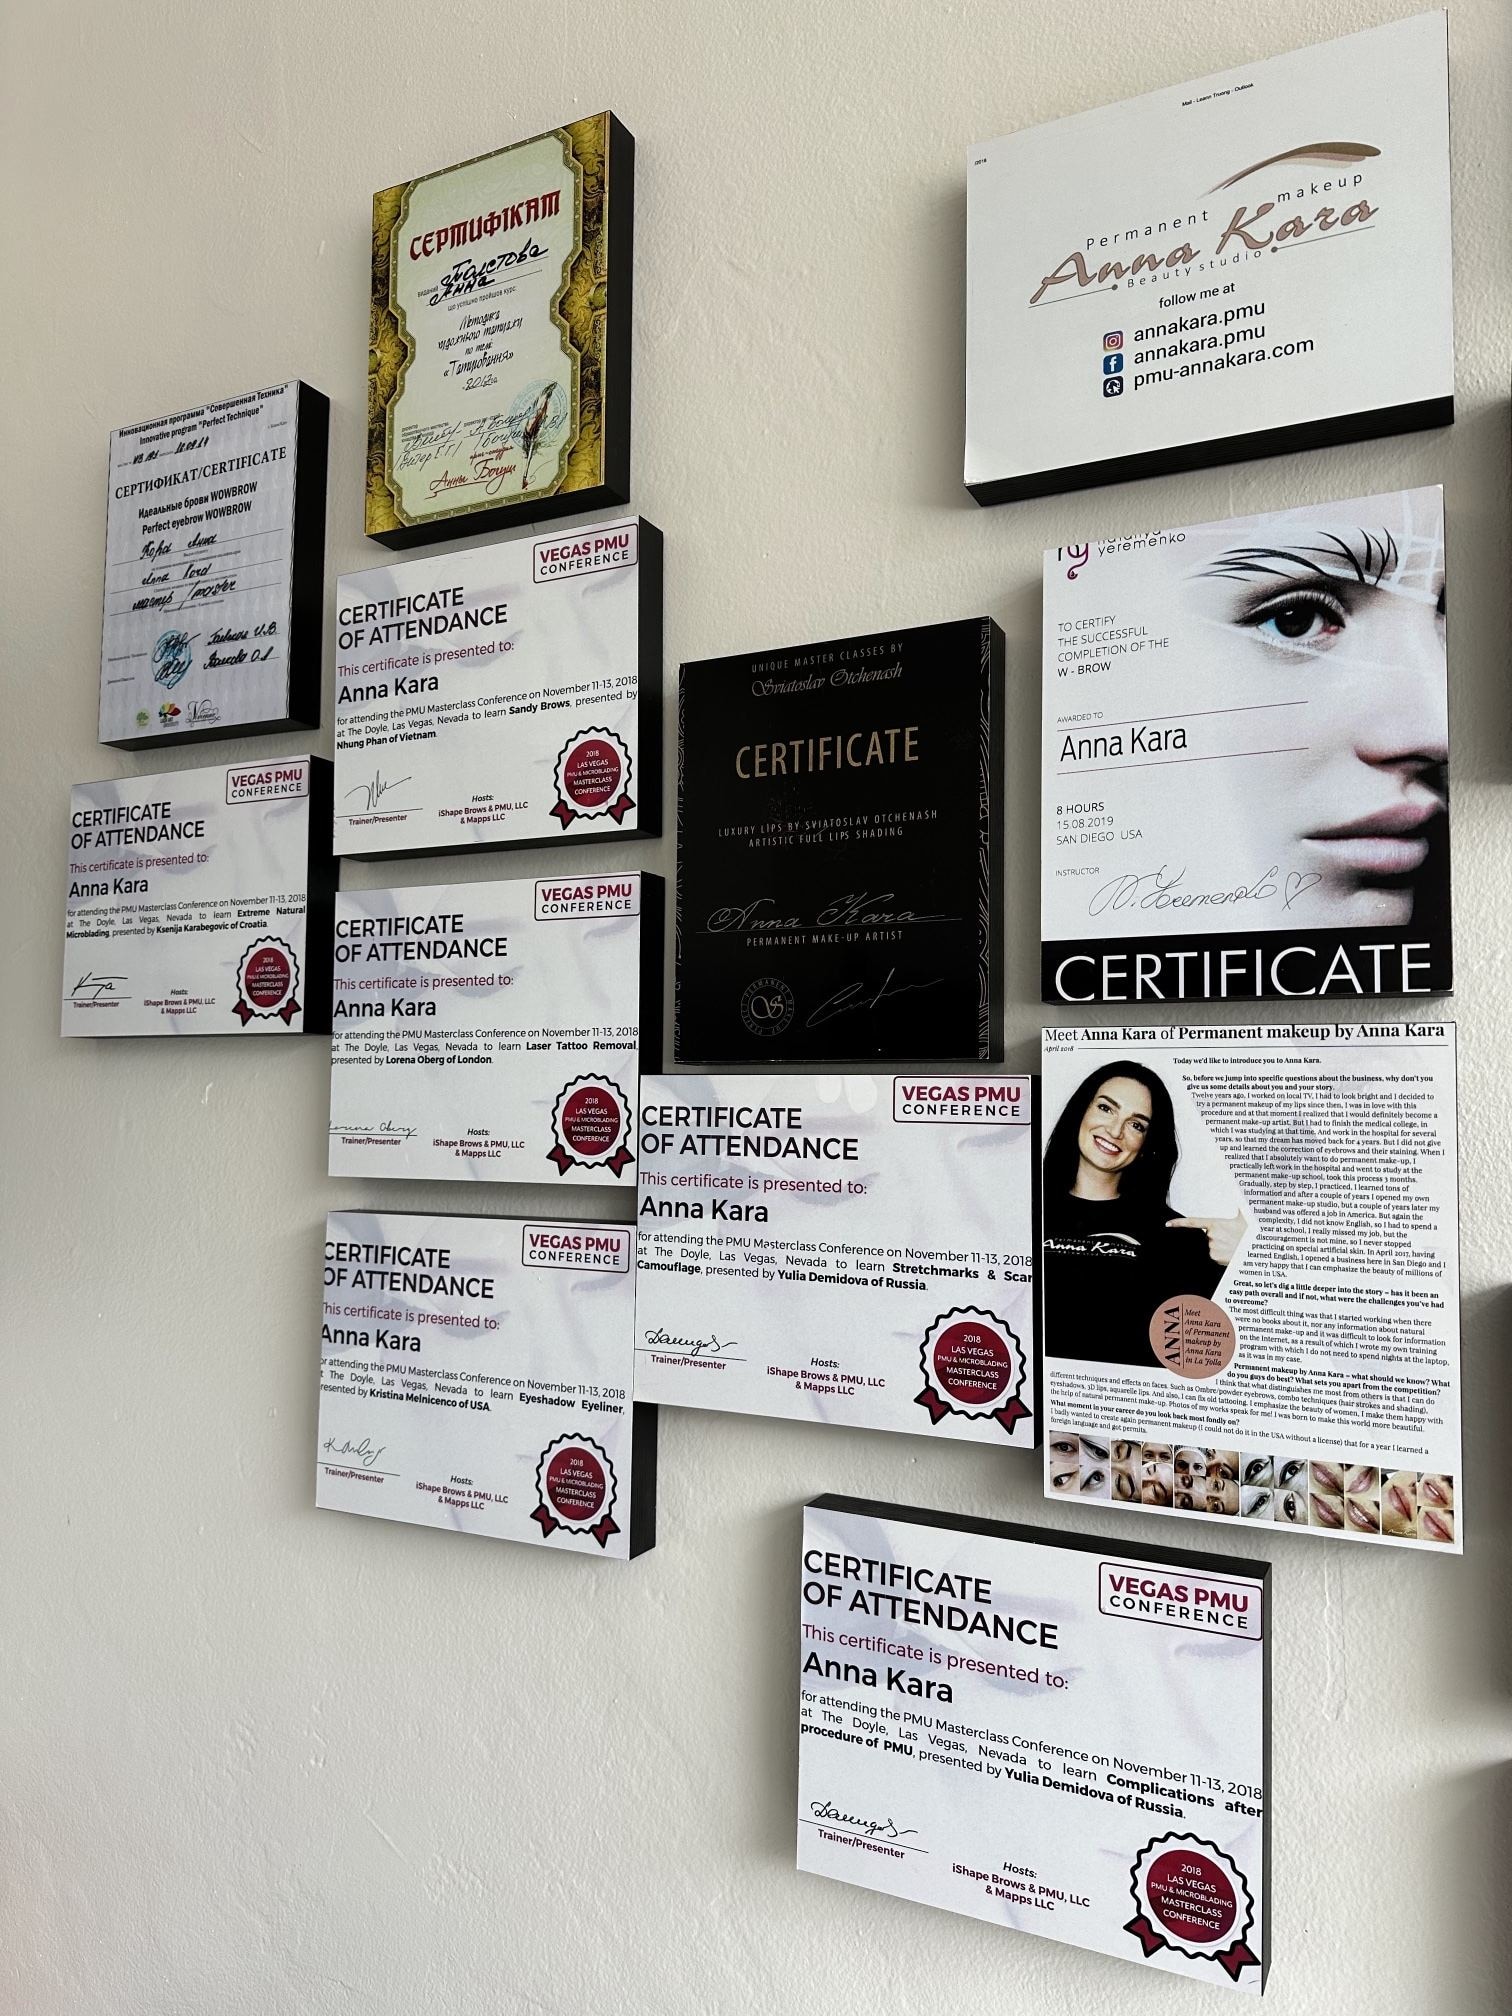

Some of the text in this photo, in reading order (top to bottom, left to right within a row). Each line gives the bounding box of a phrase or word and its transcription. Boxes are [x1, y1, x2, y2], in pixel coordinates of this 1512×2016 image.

[1087, 172, 1363, 251] Permanent makeup
[409, 191, 561, 259] СЕРТИФІКАТ
[1030, 200, 1379, 304] Anna Kara
[1127, 249, 1263, 288] Beauty studio
[1159, 282, 1235, 308] follow me at
[1134, 301, 1265, 342] annakara.pmu
[1134, 326, 1265, 365] annakara.pmu
[1134, 338, 1314, 390] pmu-annakara.com
[119, 385, 288, 438] Инновационная программа "Совершенная Техника"
[139, 404, 263, 445] Innovative program "Perfect Technique"
[115, 447, 286, 498] СЕРТИФИКАТ/CERTIFICATE
[138, 481, 258, 518] Идеальные брови WOWBROW
[142, 501, 252, 535] Perfect eyebrow WOWBROW
[539, 533, 629, 563] VEGAS PMU
[1098, 533, 1186, 558] yeremenko
[540, 550, 628, 575] CONFERENCE
[338, 587, 464, 625] CERTIFICATE
[338, 604, 507, 650] OF ATTENDANCE
[1057, 615, 1116, 632] TO CERTIFY
[1057, 626, 1148, 646] THE SUCCESSFUL
[751, 642, 903, 673] UNIQUE MASTER CLASSES BY
[1057, 637, 1169, 662] COMPLETION OF THE
[751, 662, 902, 696] Sviatoslav Otchenash
[1057, 667, 1068, 677] W
[1077, 661, 1111, 674] BROW
[337, 676, 438, 704] Anna Kara
[1056, 711, 1103, 723] AWARDED TO
[735, 727, 919, 778] CERTIFICATE
[1060, 727, 1187, 761] Anna Kara
[231, 768, 302, 787] VEGAS PMU
[231, 782, 302, 798] CONFERENCE
[72, 802, 171, 828] CERTIFICATE
[1056, 801, 1104, 815] 8 HOURS
[71, 820, 205, 849] OF ATTENDANCE
[718, 810, 938, 838] LUXURY LIPS BY SVIATOSLAV OTCHENASH
[748, 826, 903, 847] ARTISTIC FULL LIPS SHADING
[1056, 829, 1143, 845] SAN DIEGO USA
[1055, 866, 1100, 876] INSTRUCTOR
[68, 878, 148, 897] Anna Kara
[541, 883, 632, 901] VEGAS PMU
[541, 899, 631, 913] CONFERENCE
[707, 891, 945, 932] Anna Kara
[334, 914, 464, 938] CERTIFICATE
[746, 930, 902, 946] PERMANENT MAKE-UP ARTIST
[333, 937, 507, 962] OF ATTENDANCE
[1055, 944, 1431, 1001] CERTIFICATE
[331, 998, 436, 1017] Anna Kara
[1045, 1024, 1445, 1041] Meet Anna Kara of Permanent makeup by Anna Kara
[1043, 1045, 1060, 1053] April
[901, 1085, 1020, 1102] VEGAS PMU
[641, 1105, 802, 1129] CERTIFICATE
[902, 1103, 1020, 1116] CONFERENCE
[641, 1133, 858, 1160] OF ATTENDANCE
[639, 1196, 768, 1222] Anna Kara
[529, 1233, 620, 1252] VEGAS PMU
[529, 1250, 619, 1265] CONFERENCE
[351, 1270, 494, 1298] ATTENDANCE
[1184, 1308, 1201, 1317] Meet
[1184, 1318, 1221, 1328] Anna Kara
[321, 1324, 420, 1352] Anna Kara
[1164, 1306, 1180, 1366] ANNA
[1185, 1338, 1222, 1348] makeup by
[1193, 1329, 1230, 1338] Permanent
[803, 1550, 991, 1603] CERTIFICATE
[1108, 1575, 1248, 1612] VEGAS PMU
[803, 1581, 1058, 1648] OF ATTENDANCE
[1109, 1595, 1247, 1629] CONFERENCE
[802, 1652, 952, 1703] Anna Kara
